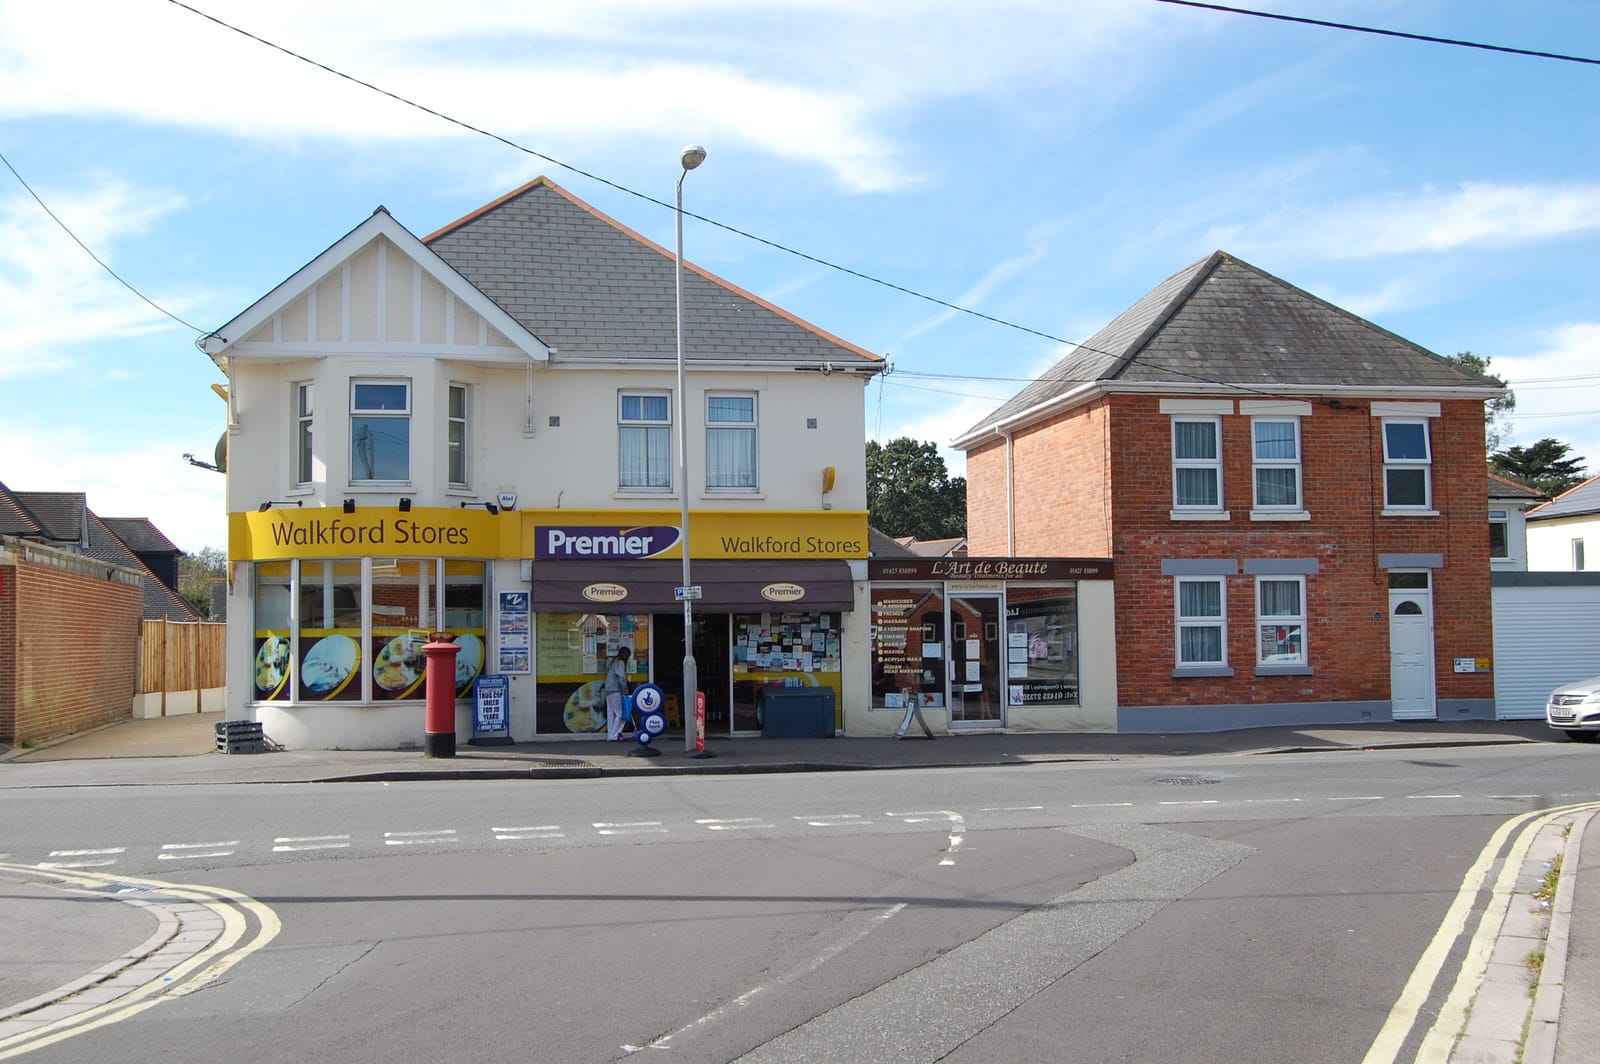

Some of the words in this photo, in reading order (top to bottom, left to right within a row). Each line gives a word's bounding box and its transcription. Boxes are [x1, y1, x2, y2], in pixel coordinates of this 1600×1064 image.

[271, 519, 385, 546] Walkford
[394, 519, 469, 545] Stores
[548, 529, 653, 555] Premier
[721, 536, 801, 553] Walkford
[806, 537, 861, 553] Stores
[931, 561, 972, 575] L'Art
[974, 560, 991, 574] de
[590, 586, 625, 598] Premier
[769, 586, 803, 598] Premier
